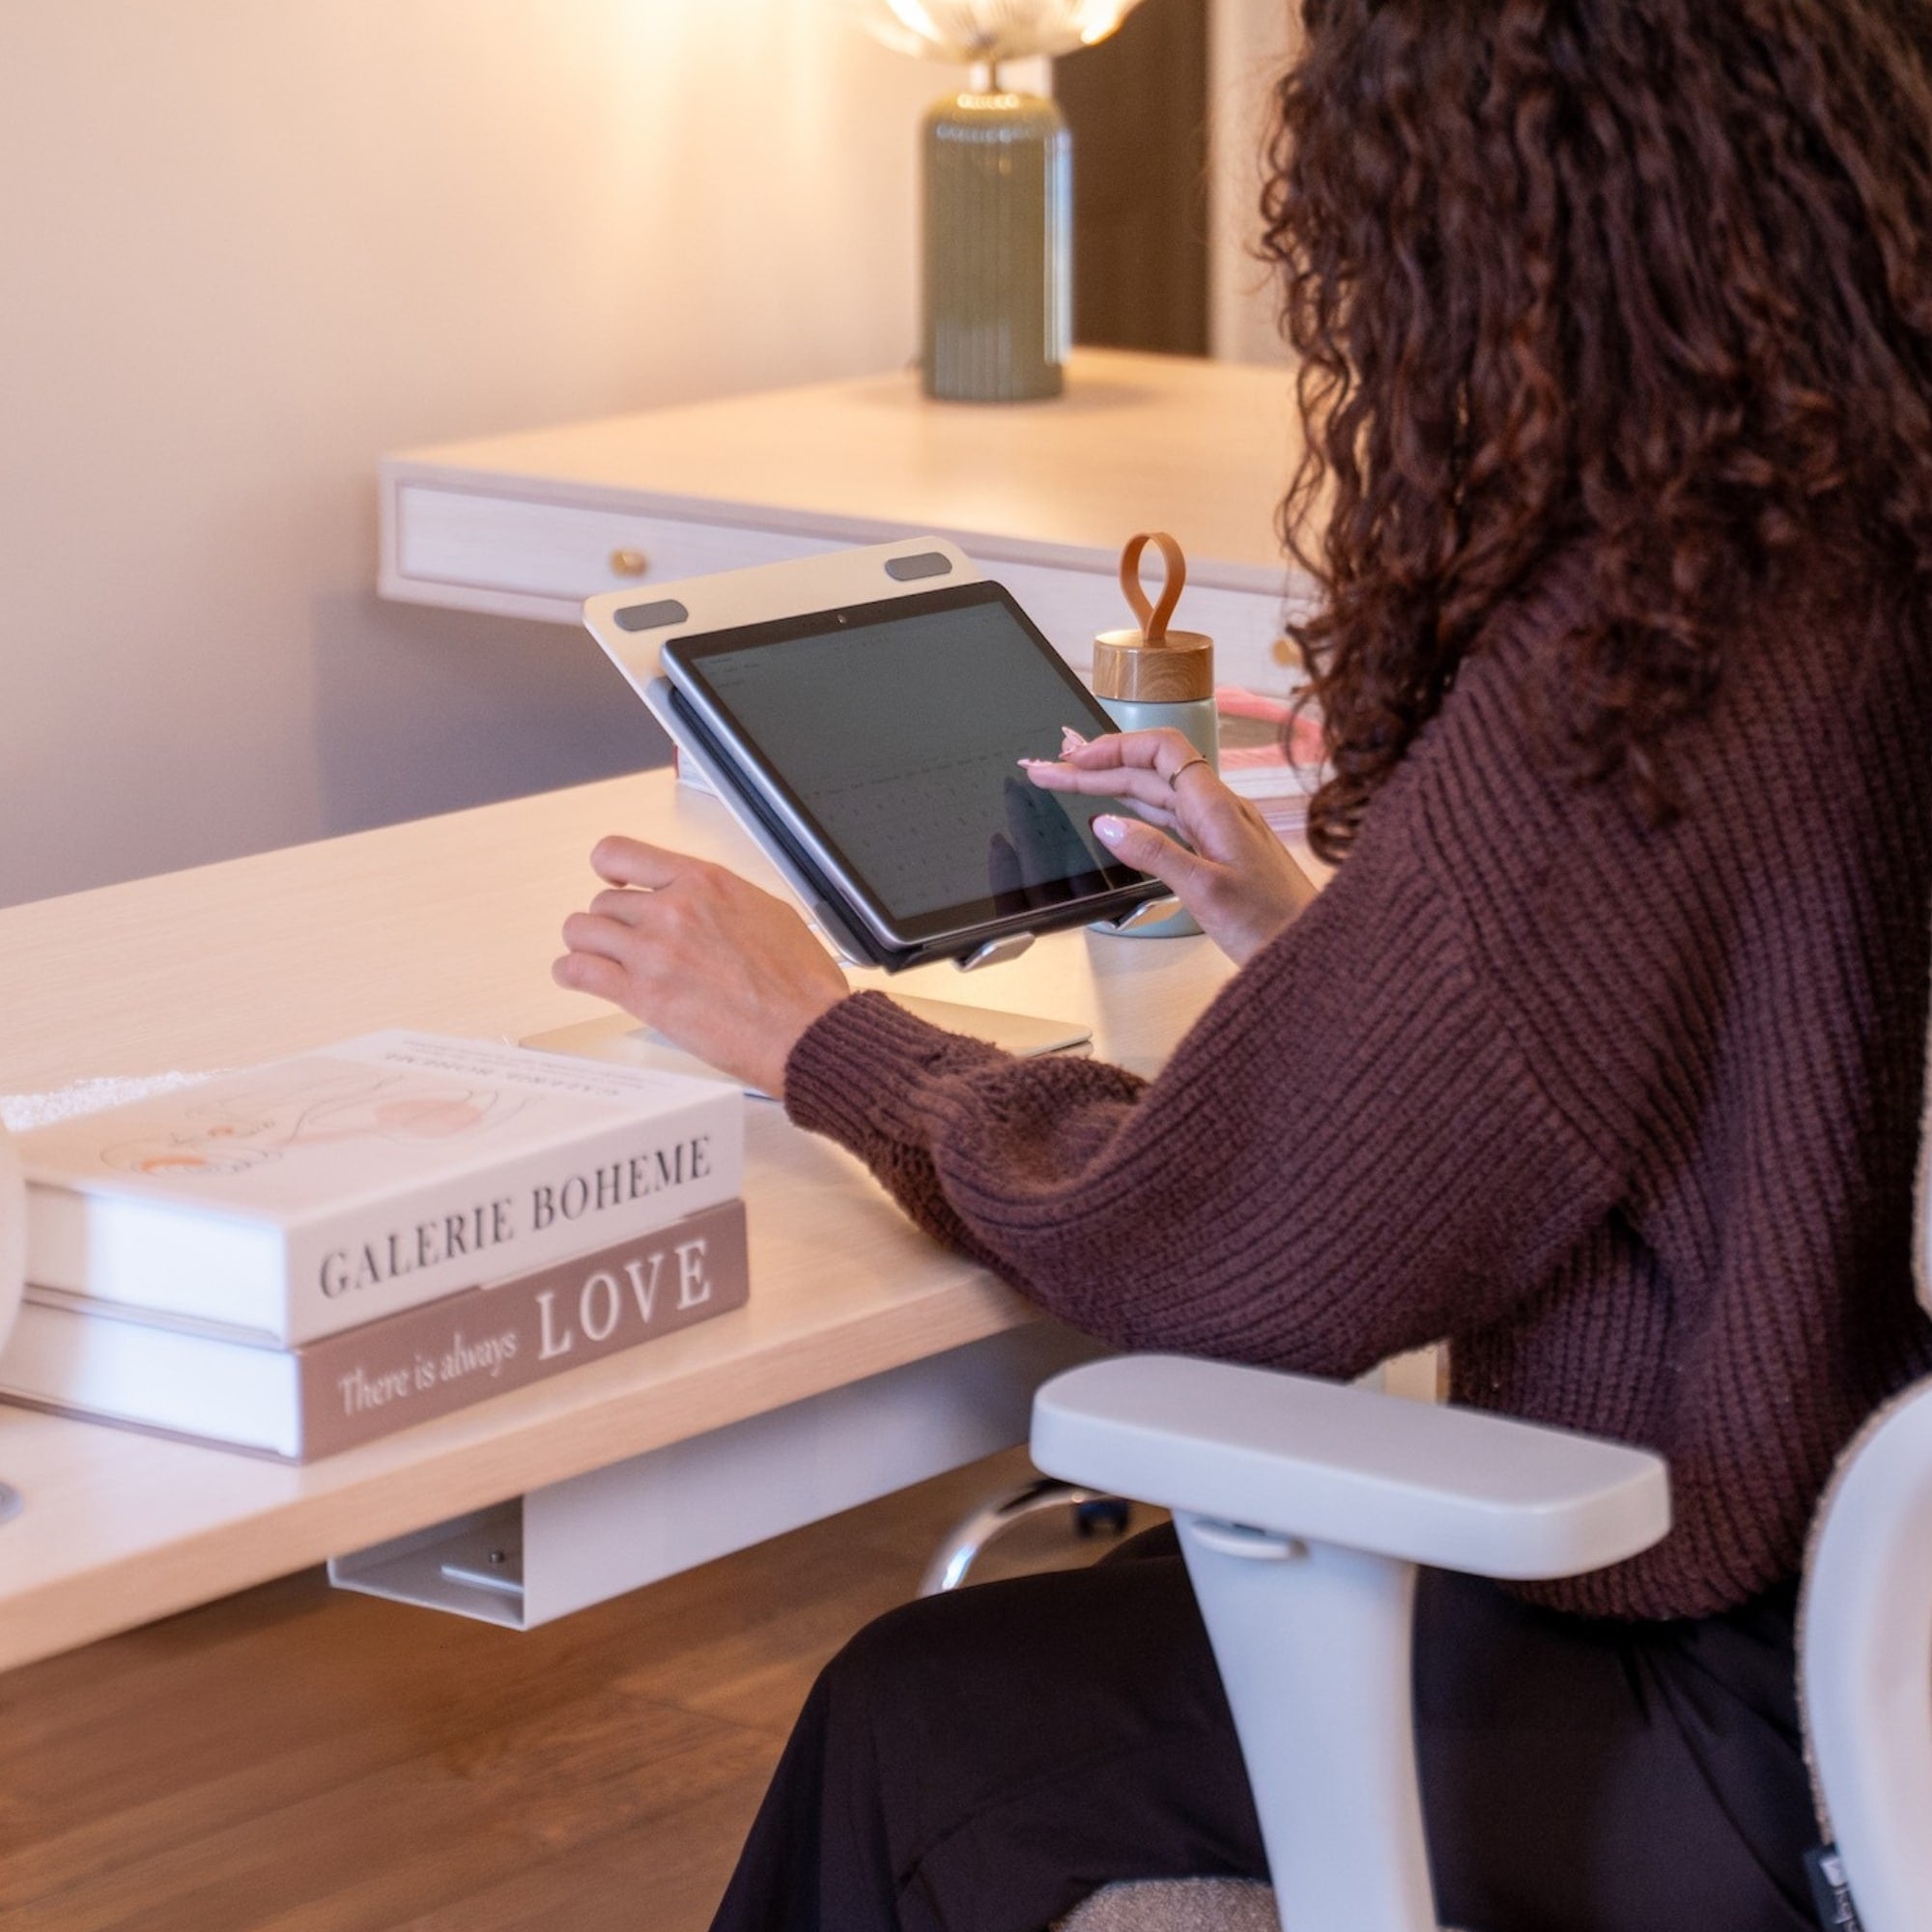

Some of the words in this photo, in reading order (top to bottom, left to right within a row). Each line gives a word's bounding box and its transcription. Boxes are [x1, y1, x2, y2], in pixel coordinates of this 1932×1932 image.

[319, 1197, 515, 1299] GALERIE
[531, 1134, 712, 1232] BOHEME
[339, 1364, 410, 1415] There
[414, 1351, 437, 1389] is
[440, 1330, 519, 1379] always
[535, 1238, 713, 1361] LOVE
